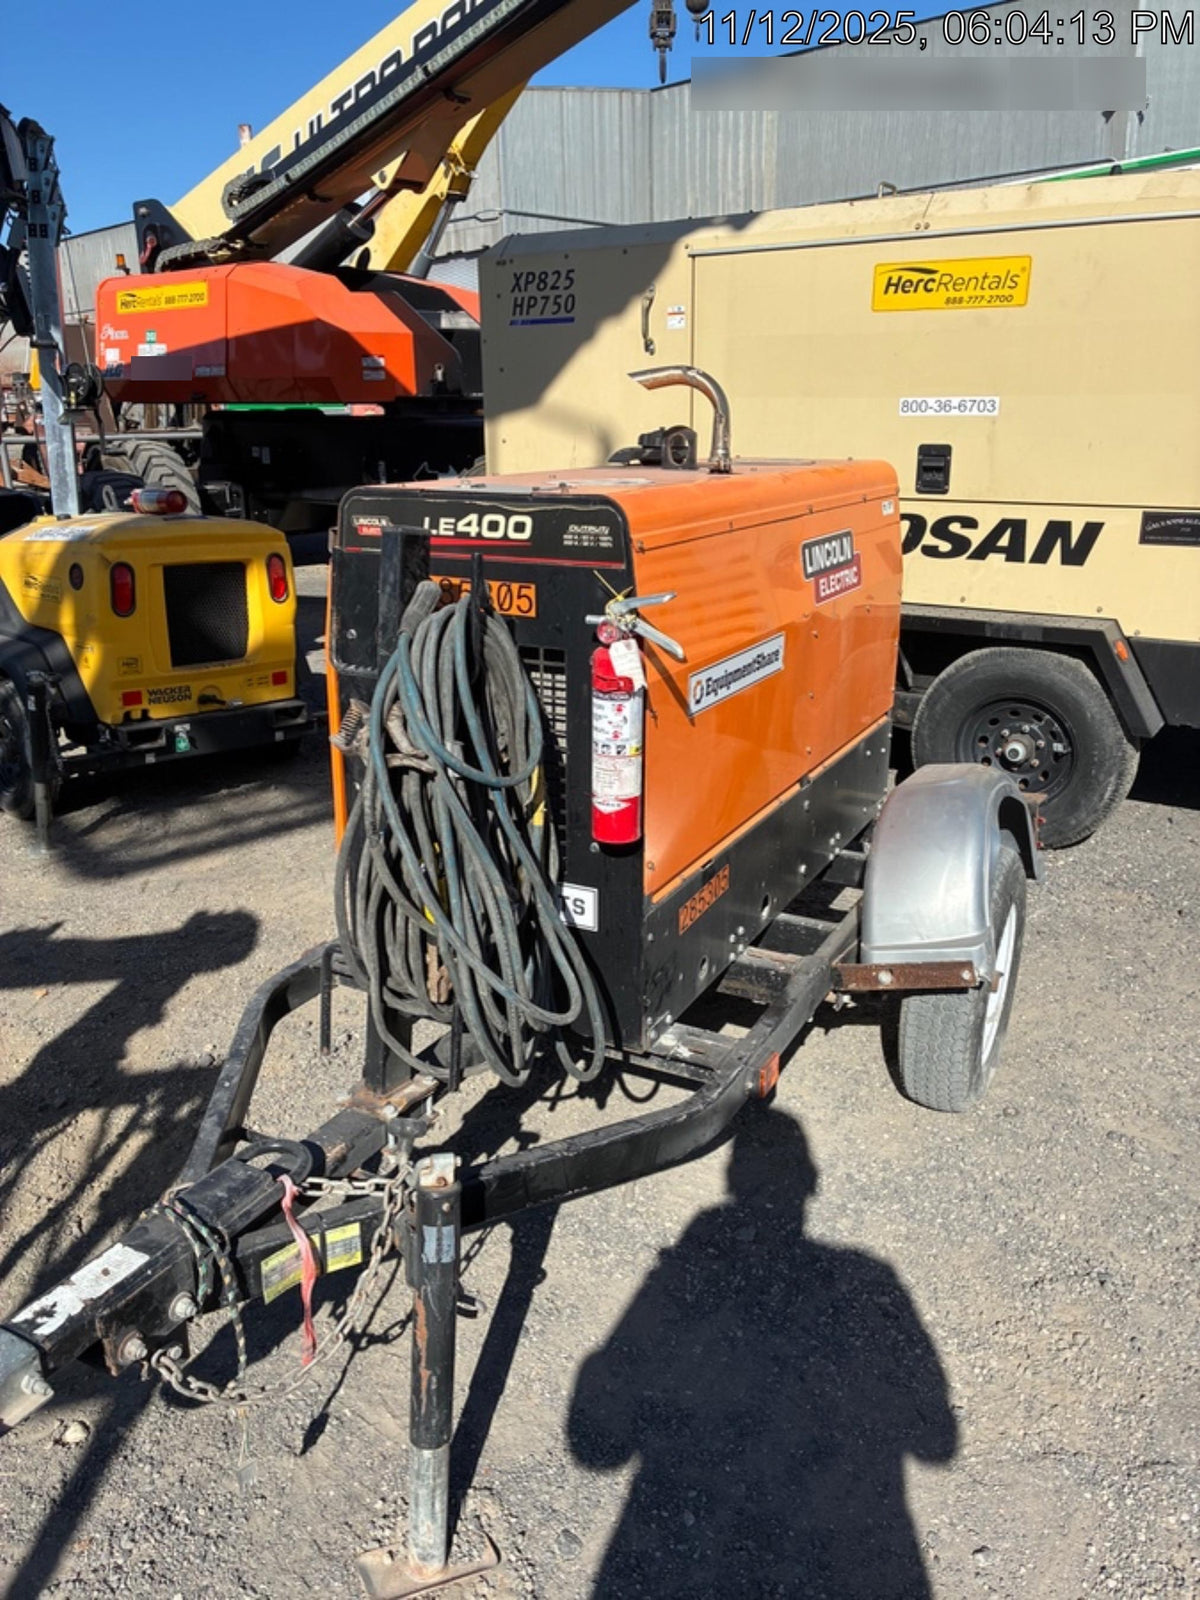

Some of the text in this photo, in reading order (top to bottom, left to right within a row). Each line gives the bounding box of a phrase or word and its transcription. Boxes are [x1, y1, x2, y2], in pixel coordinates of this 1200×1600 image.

[510, 269, 576, 293] XP825
[511, 294, 576, 317] HP750
[901, 399, 997, 413] 800-36-6703
[424, 512, 533, 540] LE400
[804, 536, 853, 573] LINCOLN
[819, 566, 859, 598] ELECTRIC
[706, 649, 780, 697] EquipmentShare
[147, 685, 192, 697] WACKER
[148, 693, 193, 705] NEUSON
